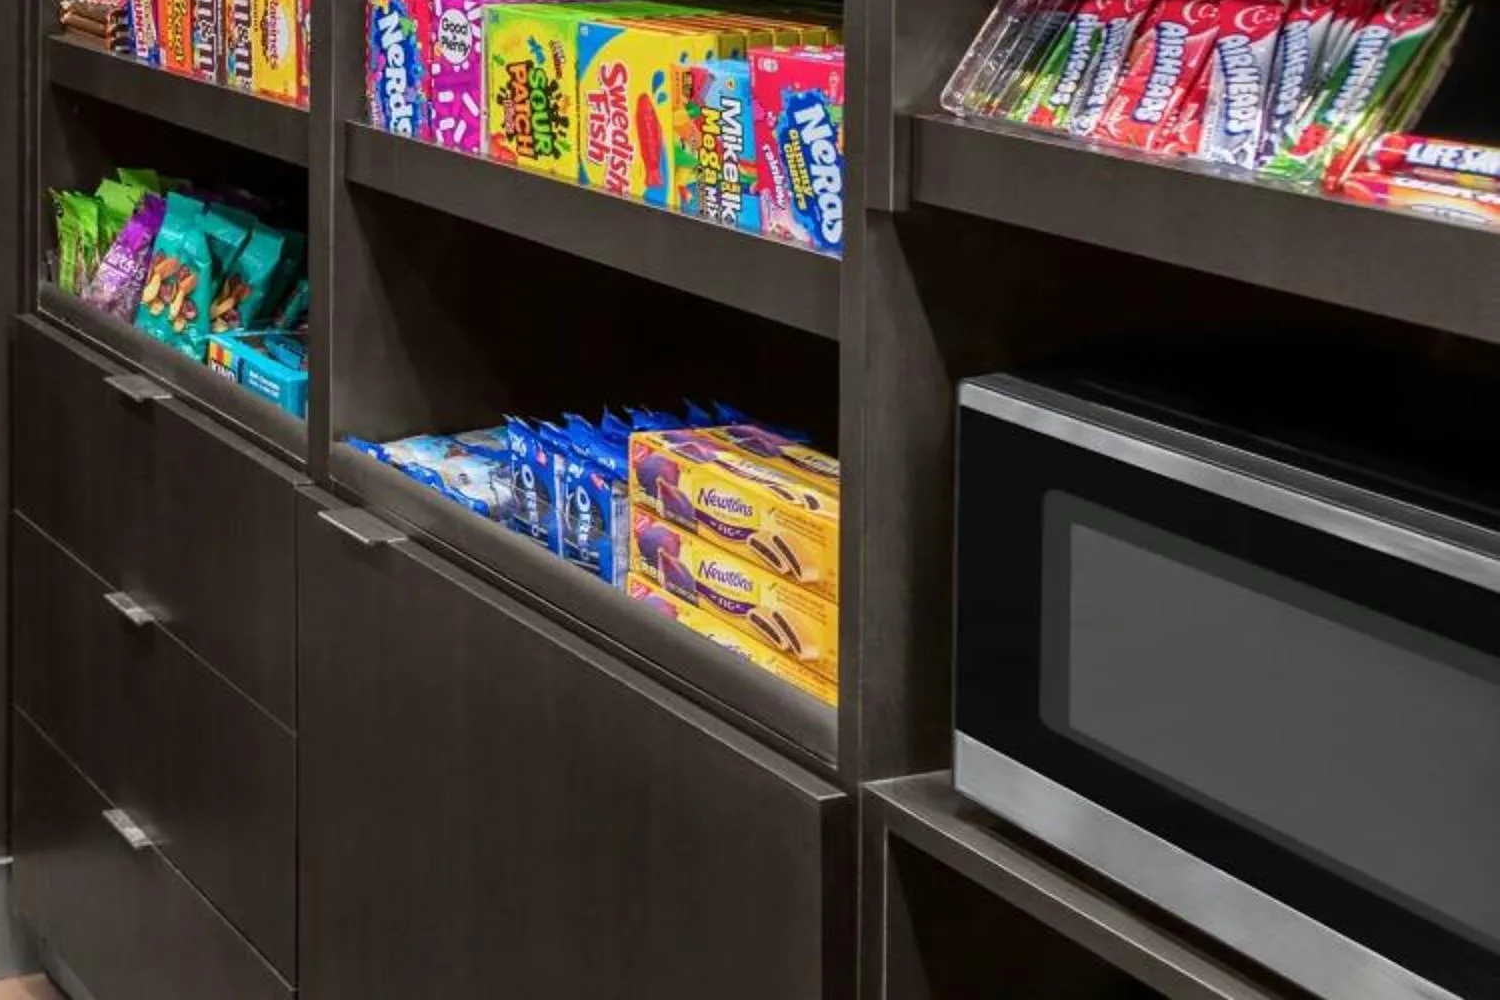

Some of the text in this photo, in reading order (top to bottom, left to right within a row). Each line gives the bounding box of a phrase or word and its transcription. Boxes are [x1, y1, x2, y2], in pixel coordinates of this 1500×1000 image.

[507, 62, 534, 158] PATCH
[529, 67, 552, 157] SOUR
[586, 92, 612, 166] Fish
[601, 61, 636, 198] Swedish
[700, 107, 722, 185] Mega
[697, 486, 755, 519] Newtons
[698, 559, 755, 592] Newtons
